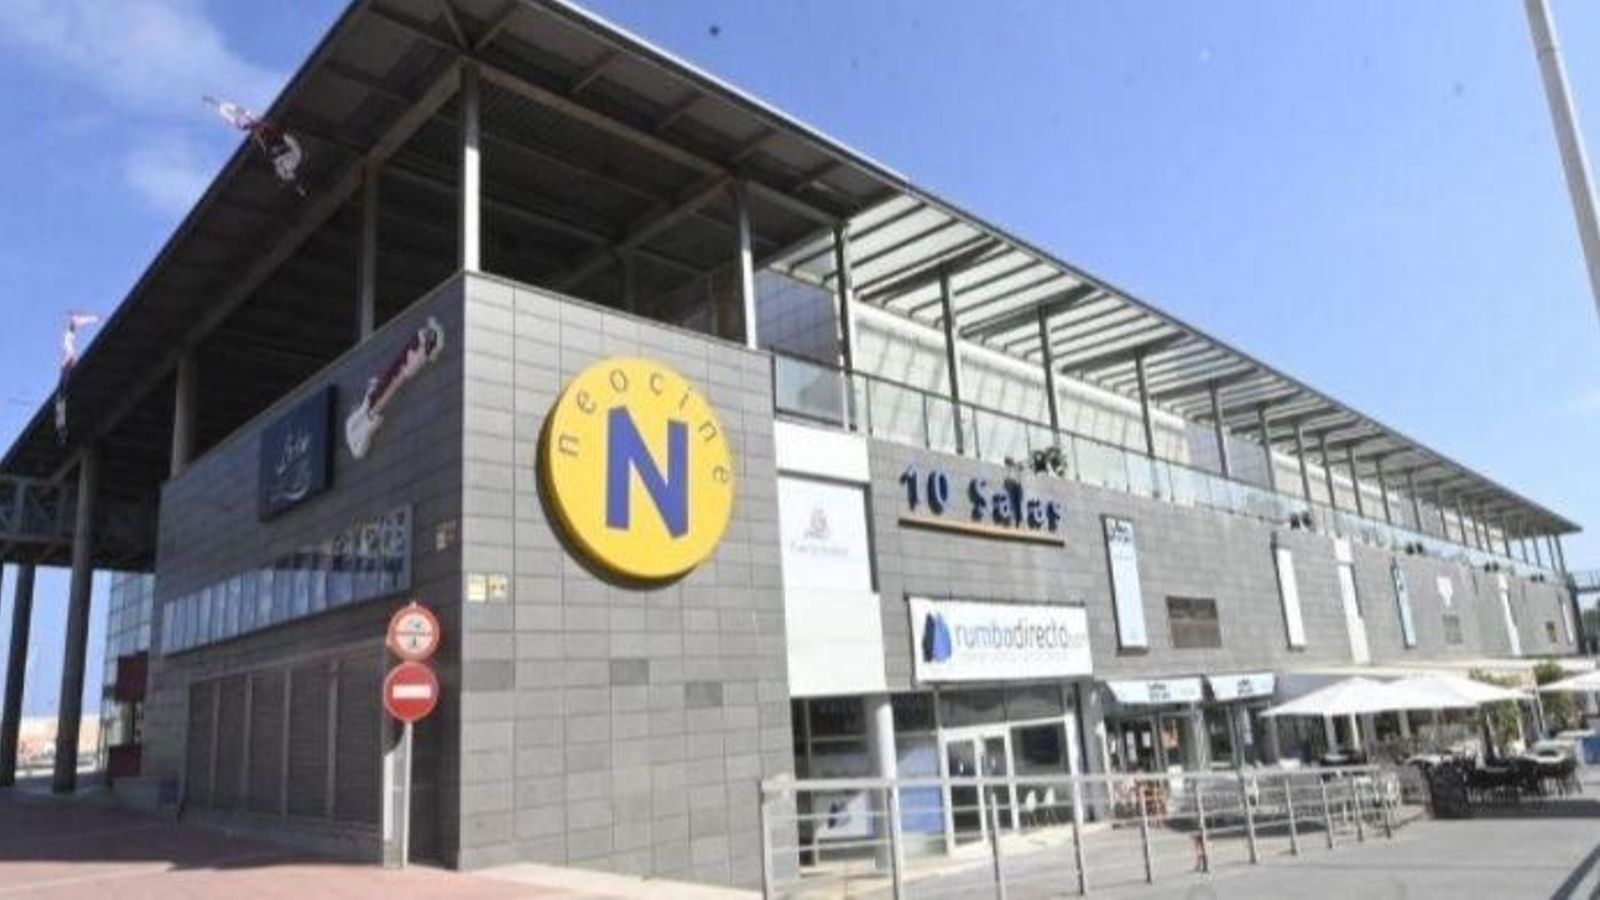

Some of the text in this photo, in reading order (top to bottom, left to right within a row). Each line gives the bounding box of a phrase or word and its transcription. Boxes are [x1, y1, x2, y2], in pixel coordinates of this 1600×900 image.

[558, 368, 730, 485] neocine
[605, 405, 689, 540] N
[899, 461, 1062, 532] 10 Salas
